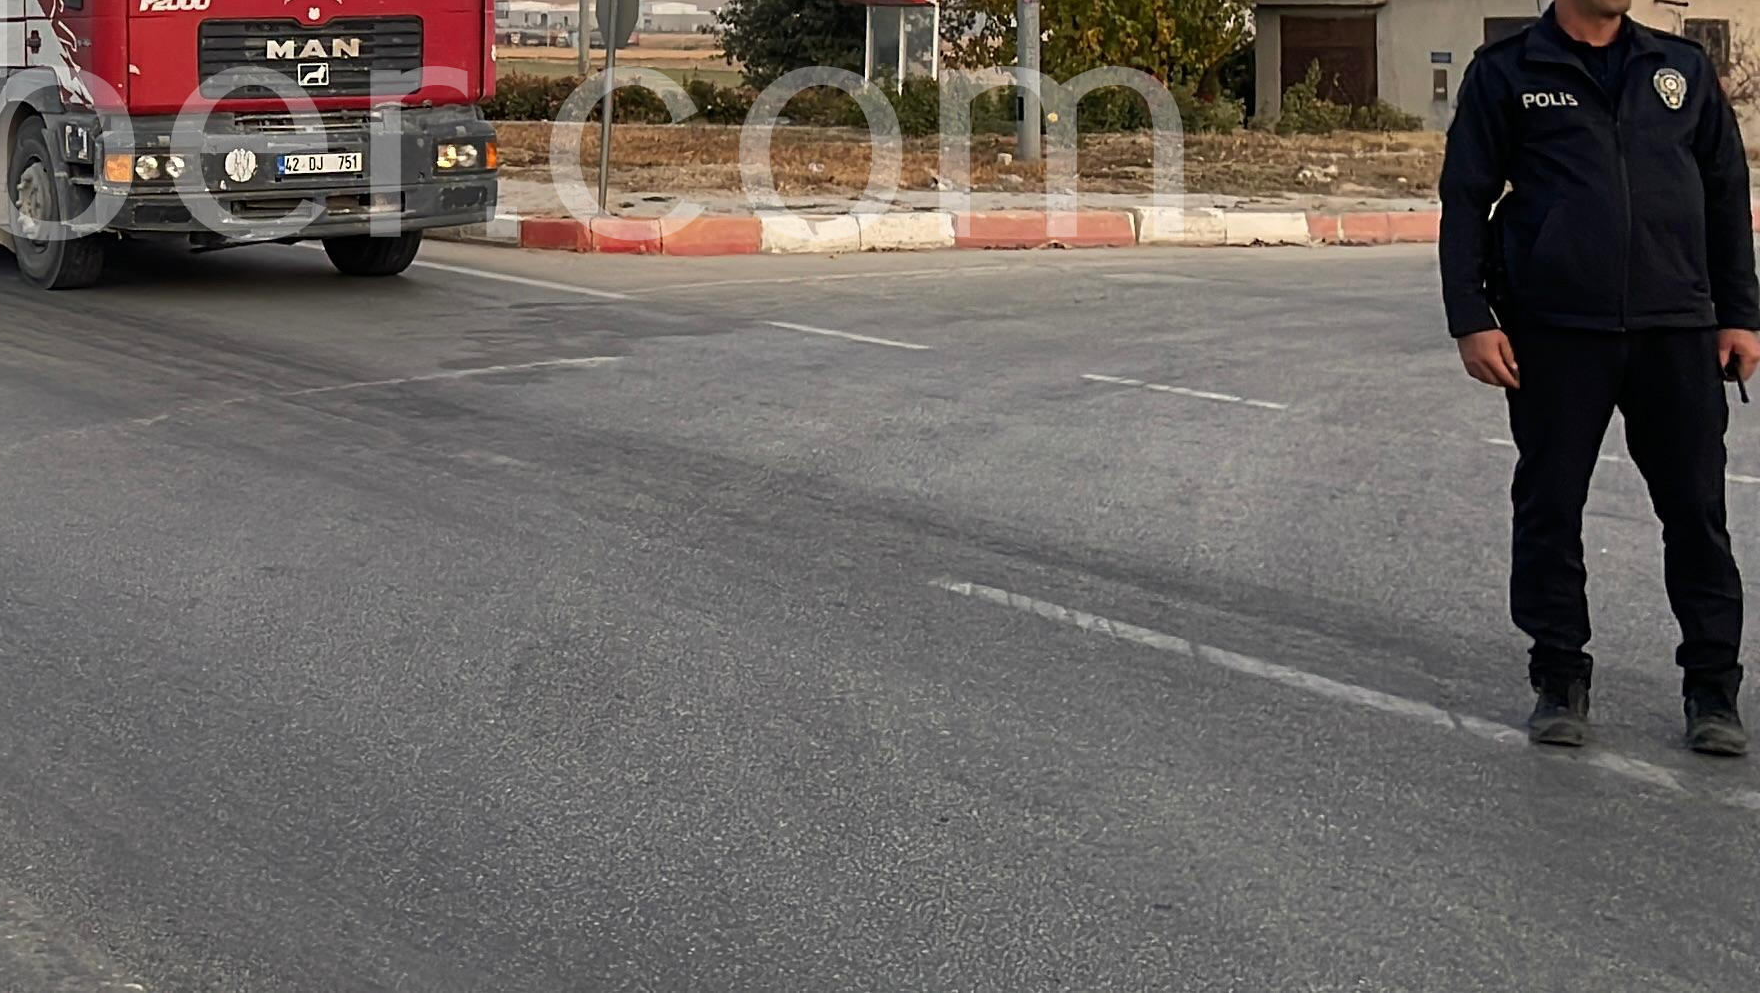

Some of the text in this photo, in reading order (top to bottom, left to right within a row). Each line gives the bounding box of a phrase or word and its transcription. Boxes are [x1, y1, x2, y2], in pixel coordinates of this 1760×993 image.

[266, 38, 361, 60] MAN
[285, 155, 357, 172] 42 DJ 751
